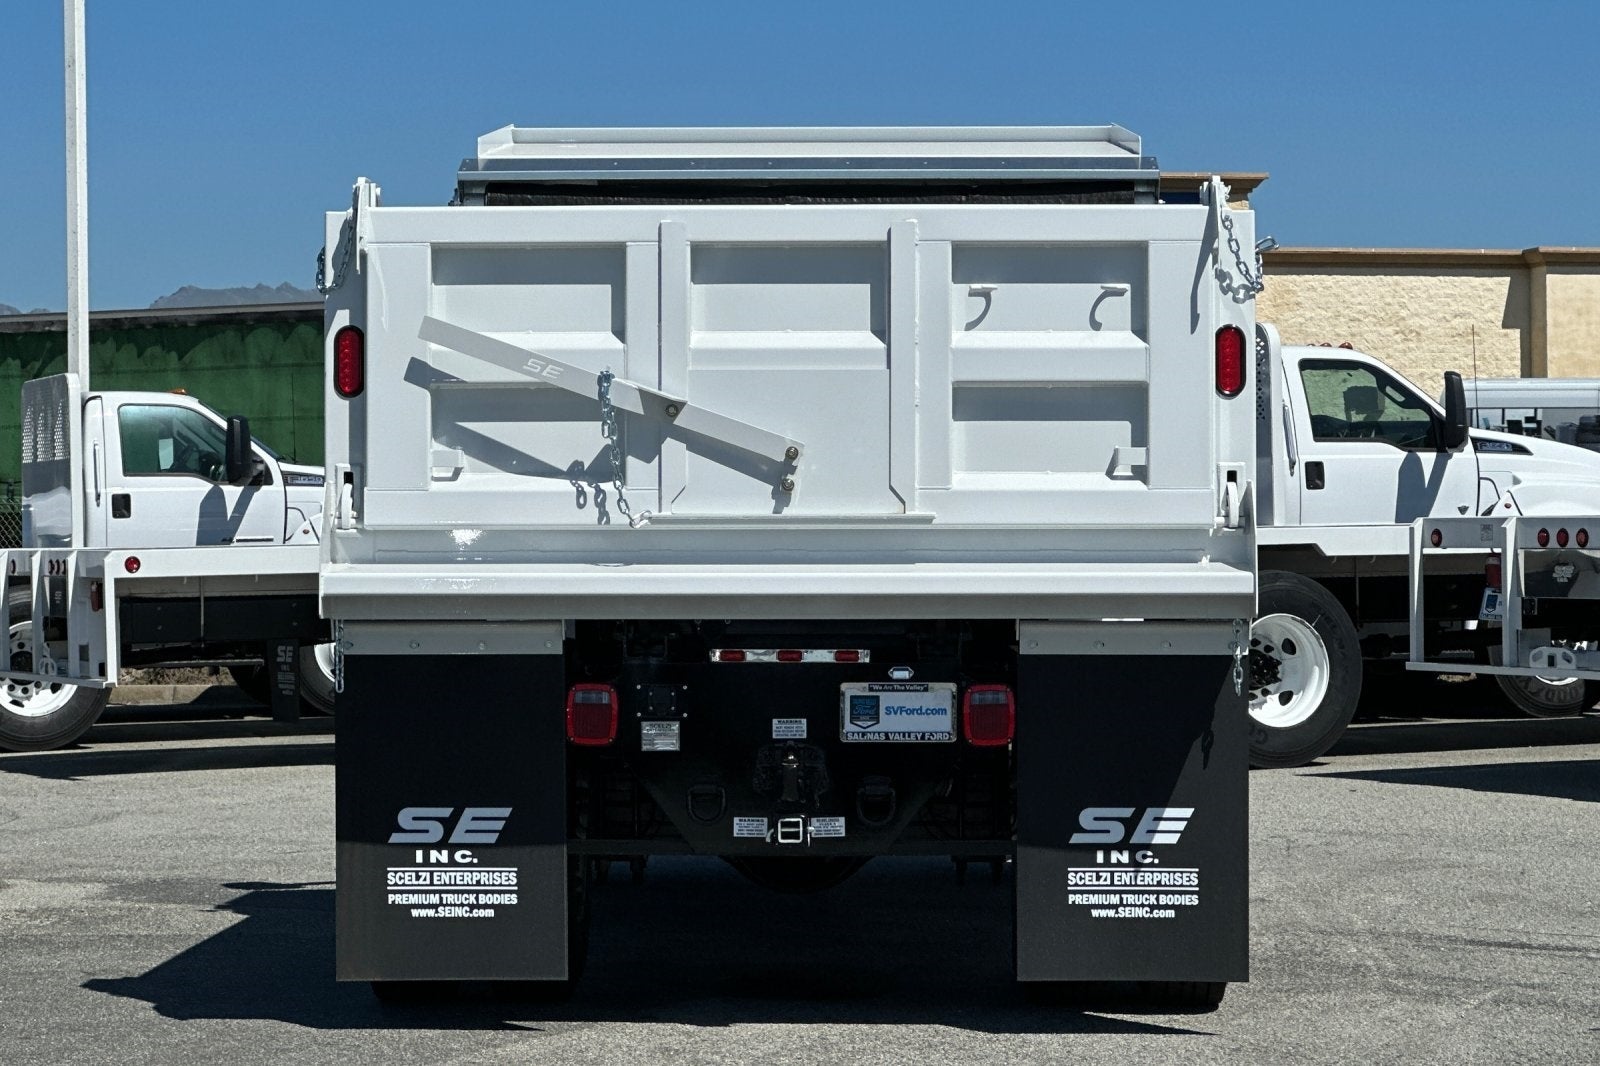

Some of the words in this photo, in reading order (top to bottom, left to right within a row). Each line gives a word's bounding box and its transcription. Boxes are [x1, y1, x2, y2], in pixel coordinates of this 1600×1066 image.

[522, 358, 564, 379] SE
[852, 704, 877, 715] Ford
[884, 705, 948, 716] SVFord.com
[847, 732, 886, 740] SALINAS
[888, 732, 922, 740] VALLEY
[925, 732, 950, 740] FORD
[388, 807, 513, 844] SE
[1069, 807, 1195, 844] SE
[415, 850, 478, 863] INC.
[1096, 850, 1159, 864] INC.
[387, 872, 431, 885] SCELZI
[433, 872, 517, 885] ENTERPRISES
[1067, 872, 1111, 885] SCELZI
[1113, 872, 1199, 886] ENTERPRISES
[388, 893, 440, 905] PREMIUM
[441, 893, 477, 905] TRUCK
[478, 893, 518, 905] BODIES
[1068, 893, 1120, 905] PREMIUM
[1121, 893, 1158, 905] TRUCK
[1159, 894, 1199, 906] BODIES
[410, 906, 495, 918] www.SEINC.com
[1091, 906, 1175, 918] www.SEINC.com
